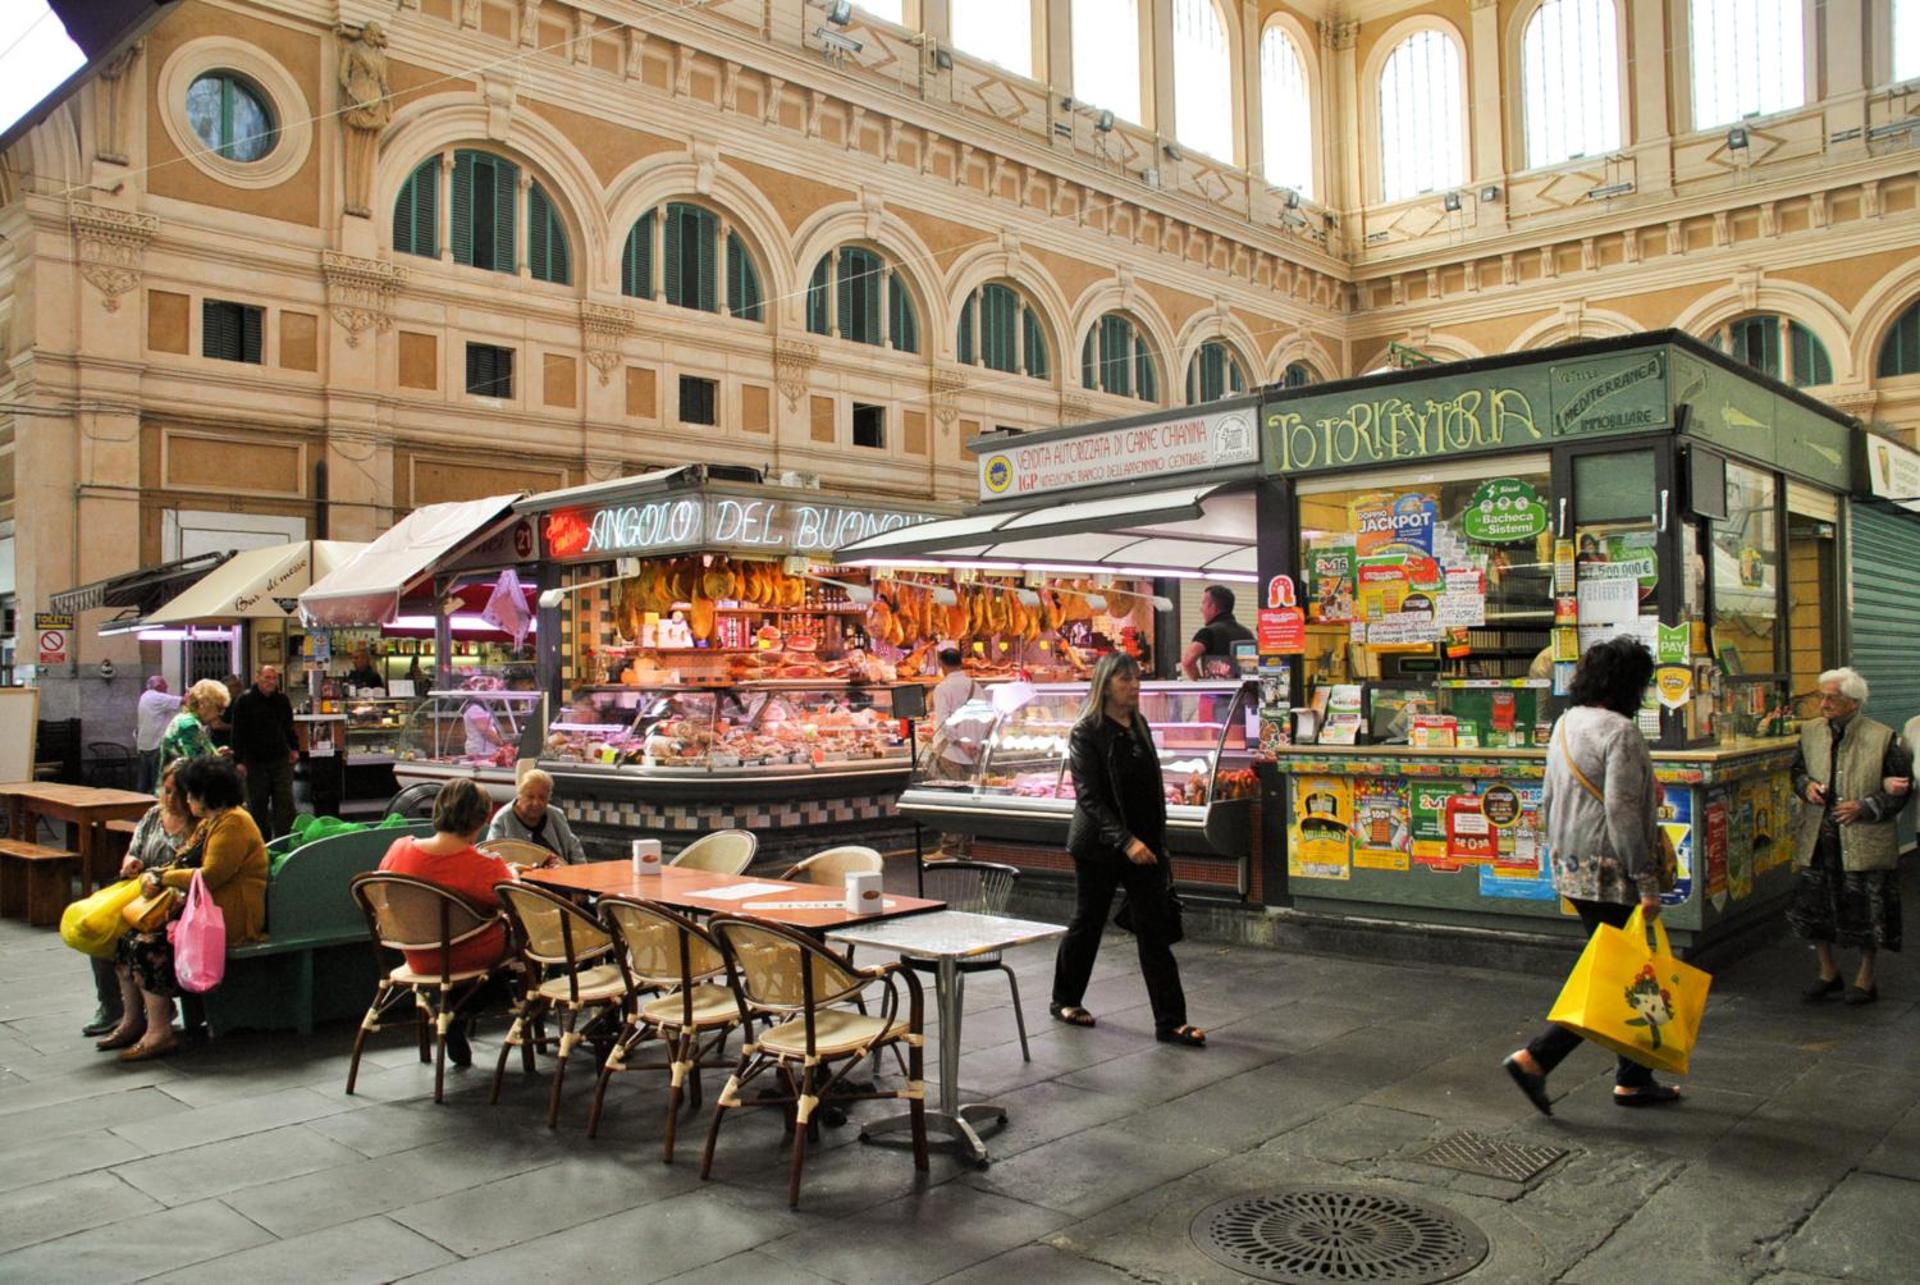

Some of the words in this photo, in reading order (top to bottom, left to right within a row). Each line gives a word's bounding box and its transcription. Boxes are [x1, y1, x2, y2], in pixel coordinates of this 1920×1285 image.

[1580, 410, 1653, 431] IMMOBILIARE
[1016, 446, 1051, 470] VENDITA
[1054, 437, 1110, 465] AUTORIZZATA
[1114, 432, 1123, 456] DI
[1125, 428, 1158, 454] CARNE
[1161, 419, 1208, 448] CHIANINA
[1018, 472, 1038, 492] IGP
[582, 501, 693, 552] ANGOLO
[715, 500, 784, 545] DEL
[1358, 511, 1432, 533] JACKPOT
[1482, 512, 1534, 524] Bacheca
[1488, 522, 1534, 535] Sistemi
[516, 529, 531, 551] 21
[1660, 641, 1684, 653] PAY
